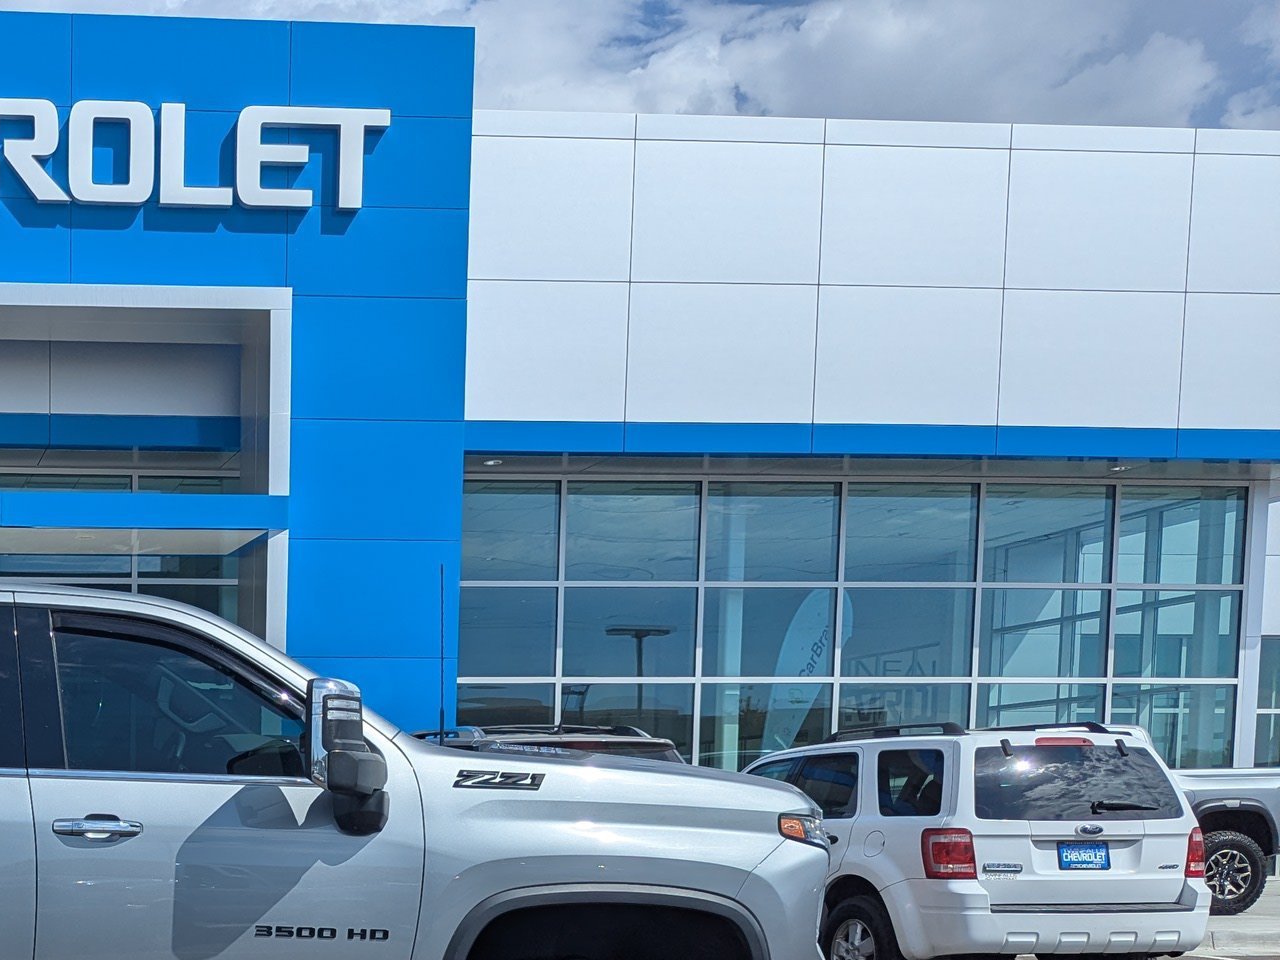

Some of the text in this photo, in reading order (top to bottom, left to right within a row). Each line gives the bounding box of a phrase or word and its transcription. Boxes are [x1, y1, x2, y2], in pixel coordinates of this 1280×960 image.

[798, 625, 830, 677] CarBra
[452, 769, 546, 791] Z71
[1063, 852, 1106, 862] CHEVROLET
[254, 925, 390, 940] 3500 HD
